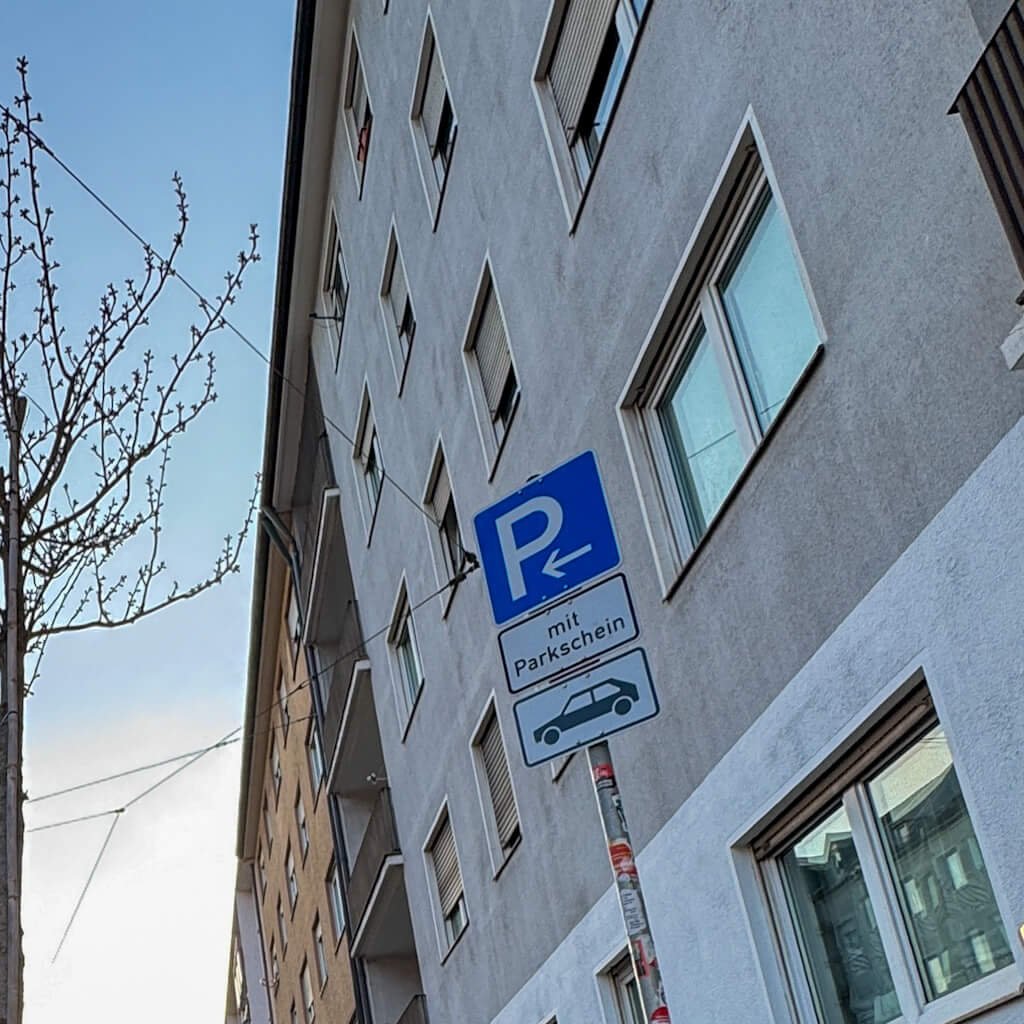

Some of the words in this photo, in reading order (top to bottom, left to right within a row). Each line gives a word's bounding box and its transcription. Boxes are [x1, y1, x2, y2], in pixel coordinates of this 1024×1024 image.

[495, 495, 564, 601] P
[514, 616, 625, 677] Parkschein
[547, 612, 580, 639] mit
